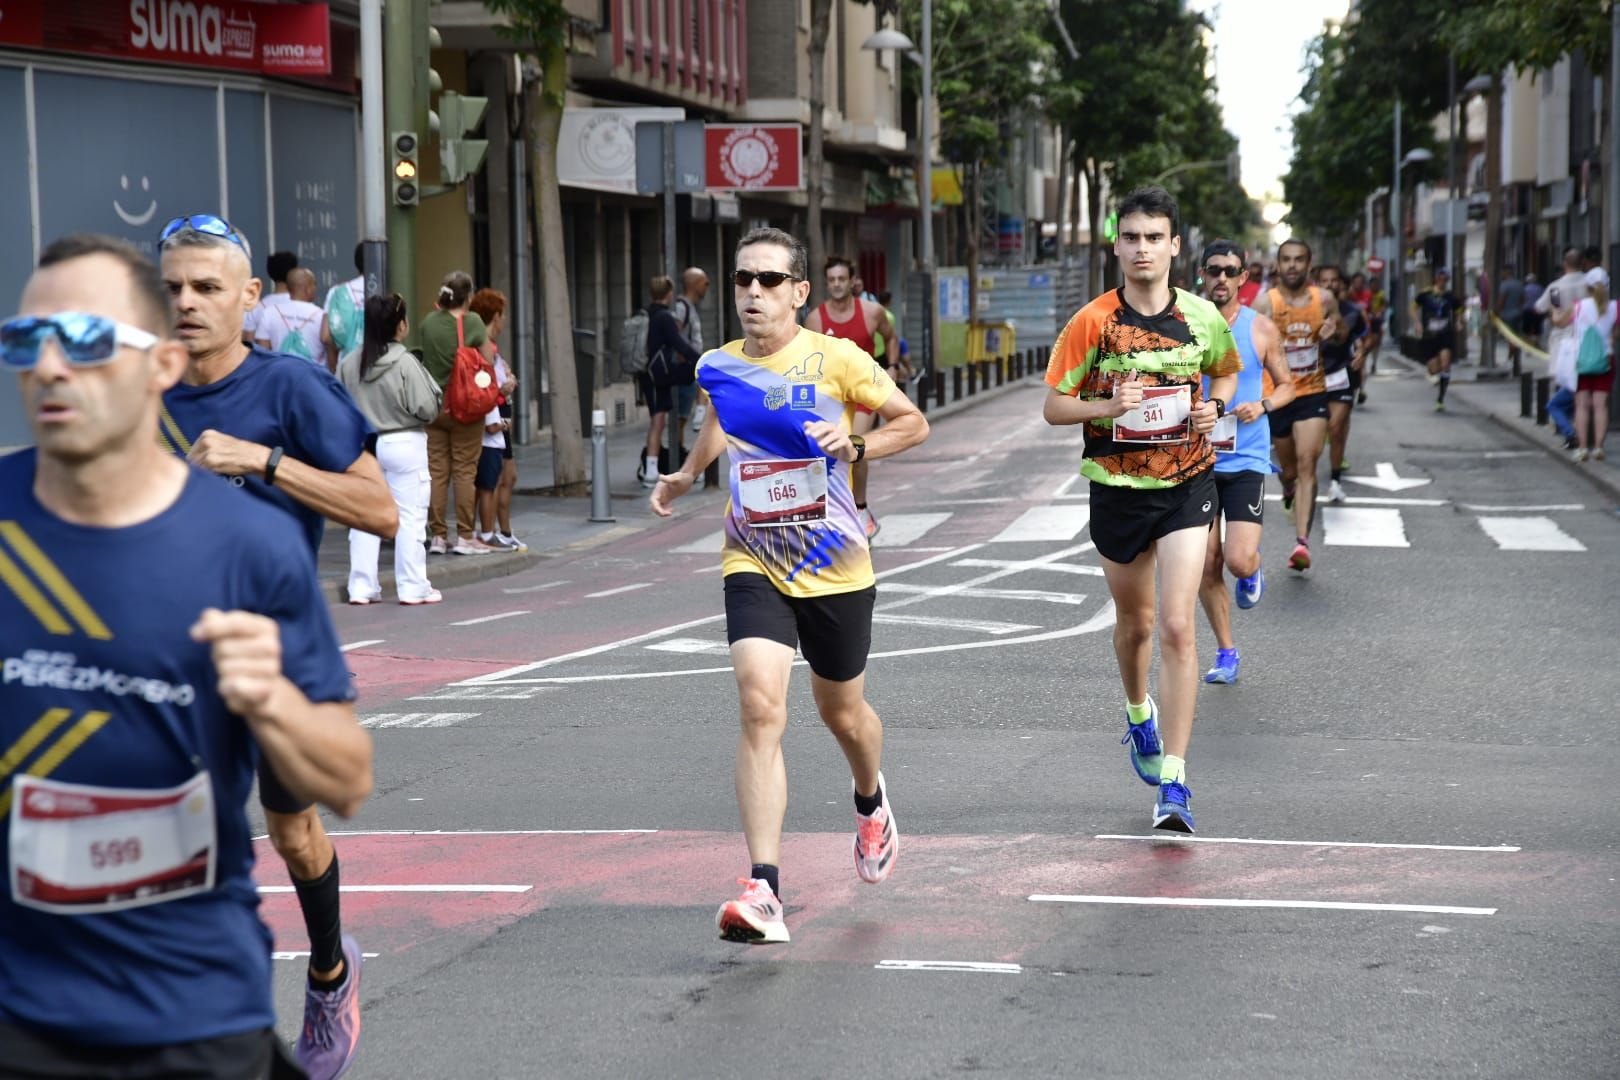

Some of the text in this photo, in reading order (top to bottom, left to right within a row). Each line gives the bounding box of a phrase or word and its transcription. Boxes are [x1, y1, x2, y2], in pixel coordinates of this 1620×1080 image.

[130, 0, 222, 55] suma
[263, 44, 304, 57] suma
[1143, 408, 1163, 423] 341
[768, 484, 796, 502] 1645
[89, 837, 143, 870] 599
